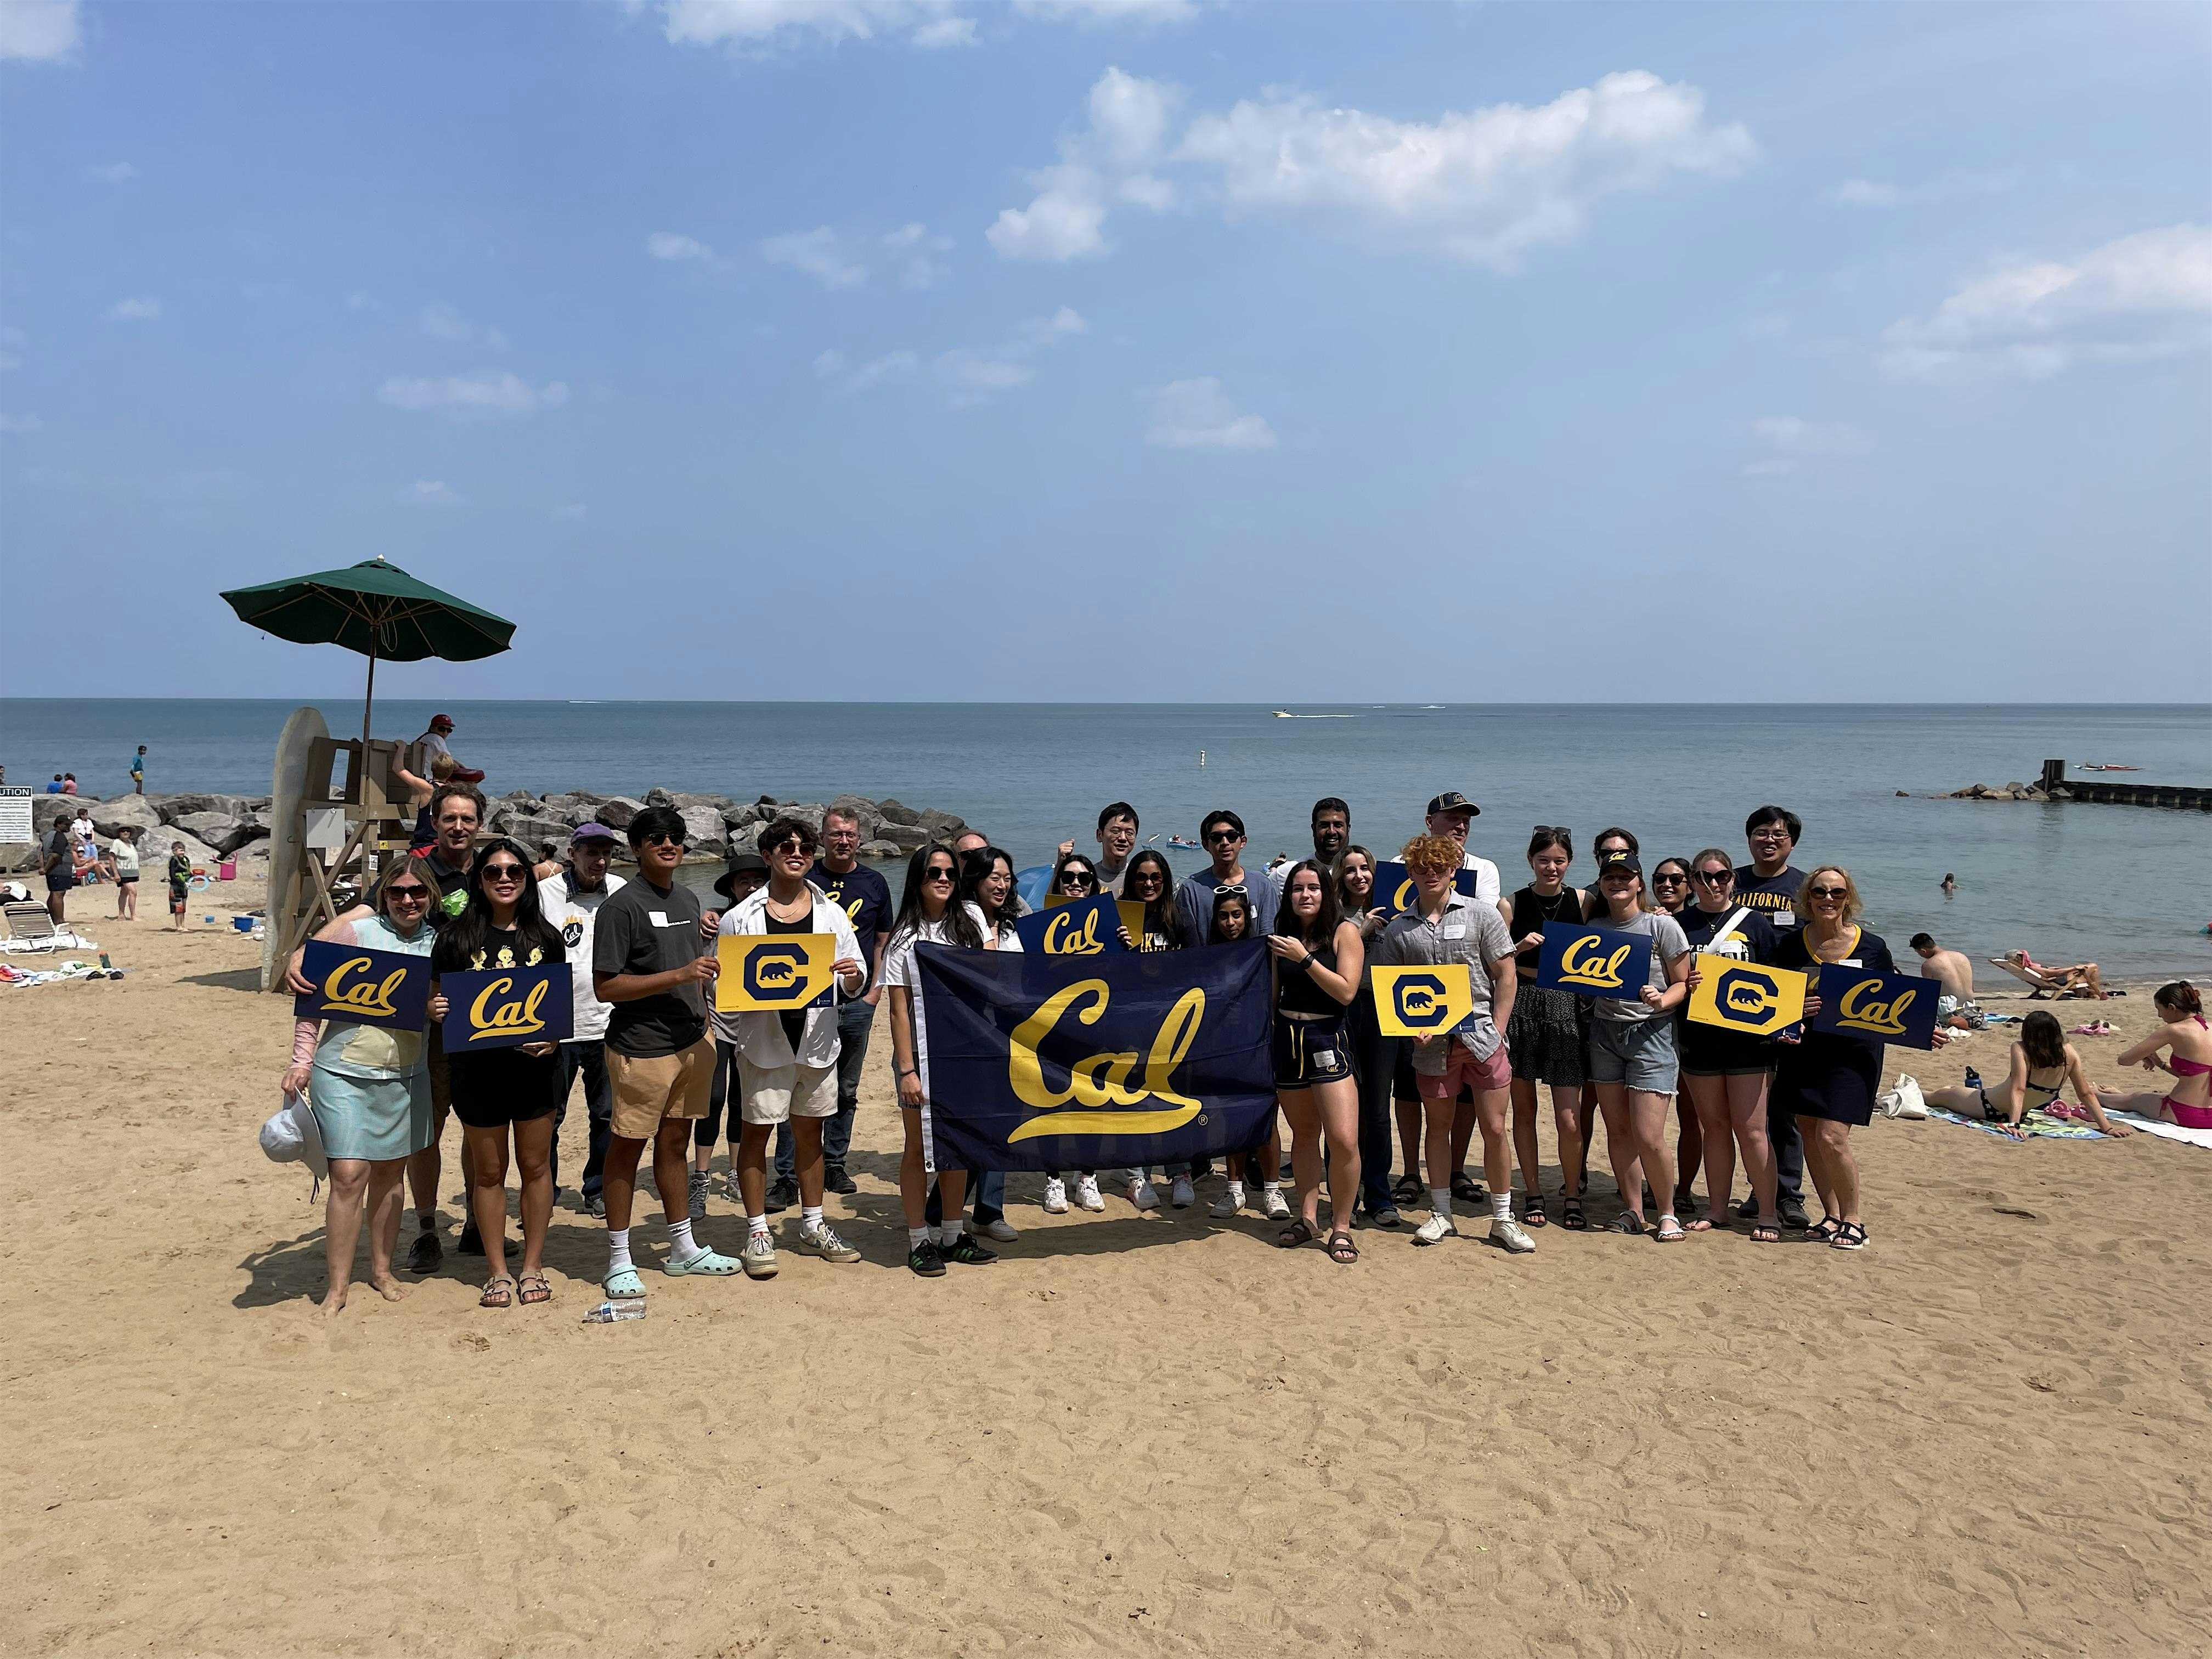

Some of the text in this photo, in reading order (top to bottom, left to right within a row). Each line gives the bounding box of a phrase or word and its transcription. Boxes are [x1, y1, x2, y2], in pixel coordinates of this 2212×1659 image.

[1609, 851, 1628, 862] Cal
[1730, 893, 1793, 912] ALIFORNIA
[564, 924, 581, 945] Cal
[1043, 908, 1104, 954] Cal
[320, 957, 407, 1017] Cal
[743, 943, 809, 1001] C
[1558, 935, 1631, 988] Cal
[469, 978, 549, 1041] Cal
[1392, 974, 1448, 1028] C
[1715, 967, 1779, 1026] C
[1835, 979, 1916, 1035] Cal
[1007, 978, 1205, 1144] Cal
